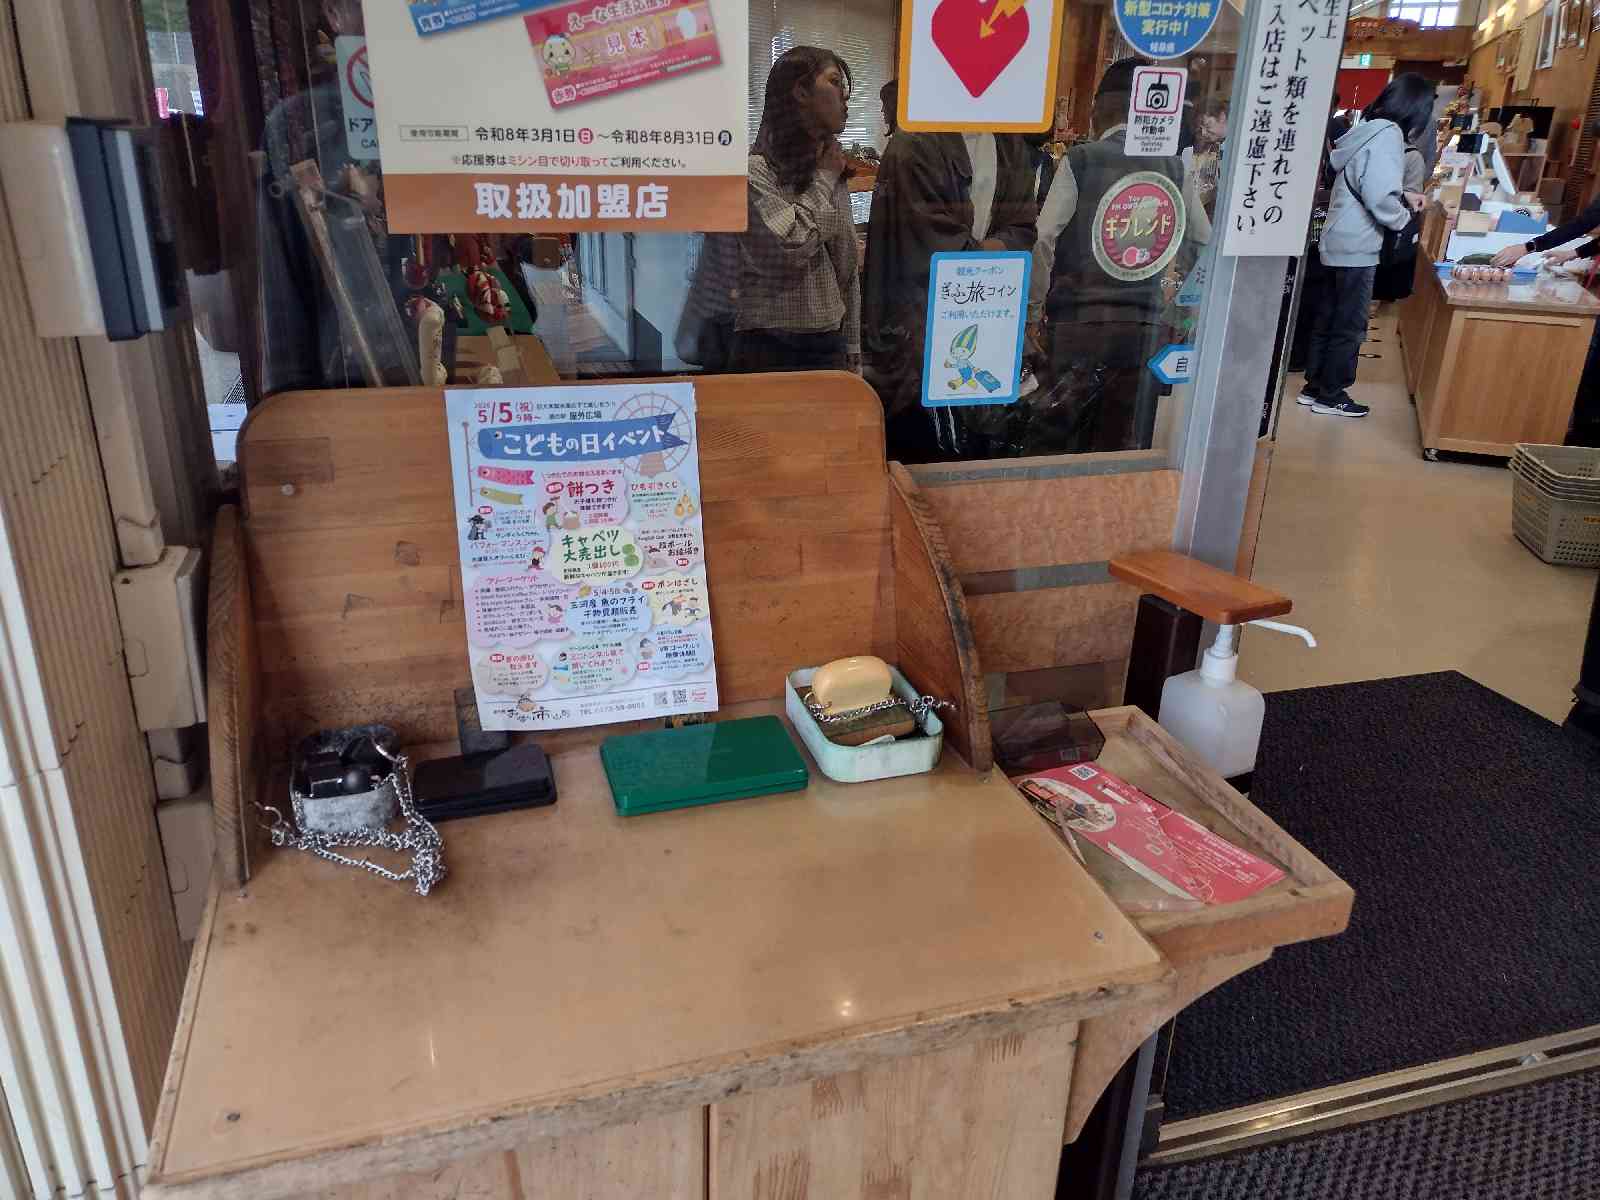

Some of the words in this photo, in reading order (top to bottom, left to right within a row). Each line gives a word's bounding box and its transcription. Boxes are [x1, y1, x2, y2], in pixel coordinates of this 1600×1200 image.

[474, 182, 669, 220] 取扱加盟店
[1105, 213, 1172, 240] ギフレンド
[941, 279, 1017, 305] ぎふ旅コイン
[504, 425, 665, 456] こどもの日イベント
[566, 480, 614, 497] 餅つき
[561, 530, 619, 548] キャベツ
[563, 544, 620, 563] 大売出し
